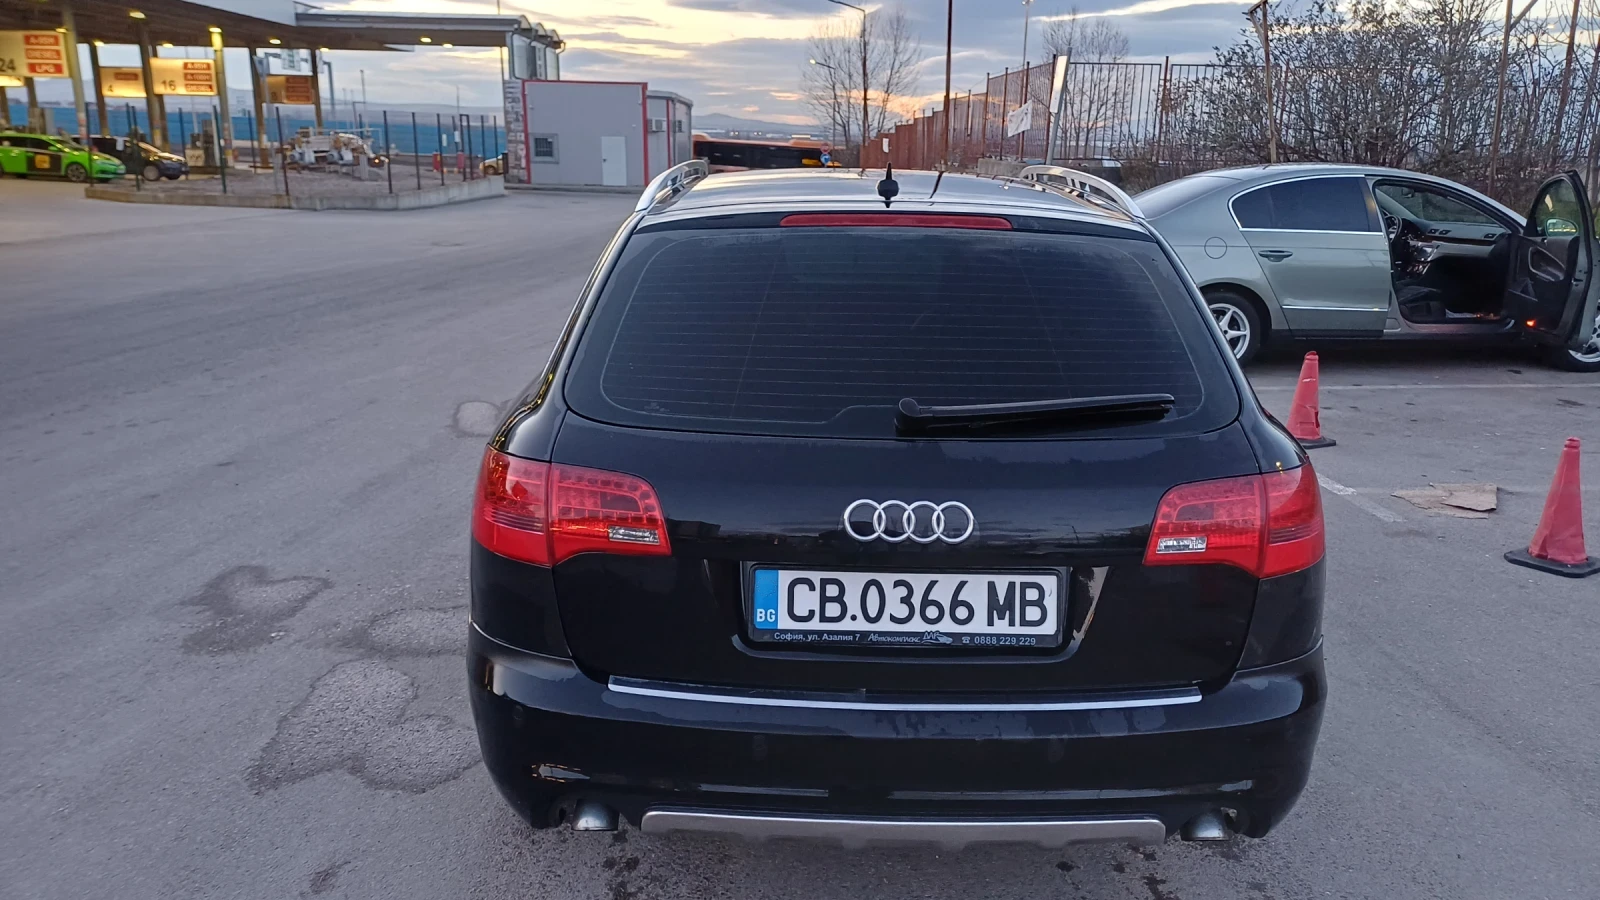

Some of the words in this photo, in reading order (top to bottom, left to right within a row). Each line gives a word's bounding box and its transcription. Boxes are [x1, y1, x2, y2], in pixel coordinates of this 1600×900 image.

[35, 64, 55, 73] LPG
[161, 80, 177, 91] 16
[986, 581, 1048, 627] MB
[756, 608, 776, 623] BG
[774, 632, 805, 642] София,
[807, 634, 820, 642] ул.
[822, 633, 853, 641] Азалия
[855, 633, 861, 641] 7
[974, 636, 997, 645] 0888
[999, 636, 1017, 645] 229
[1019, 637, 1036, 646] 229
